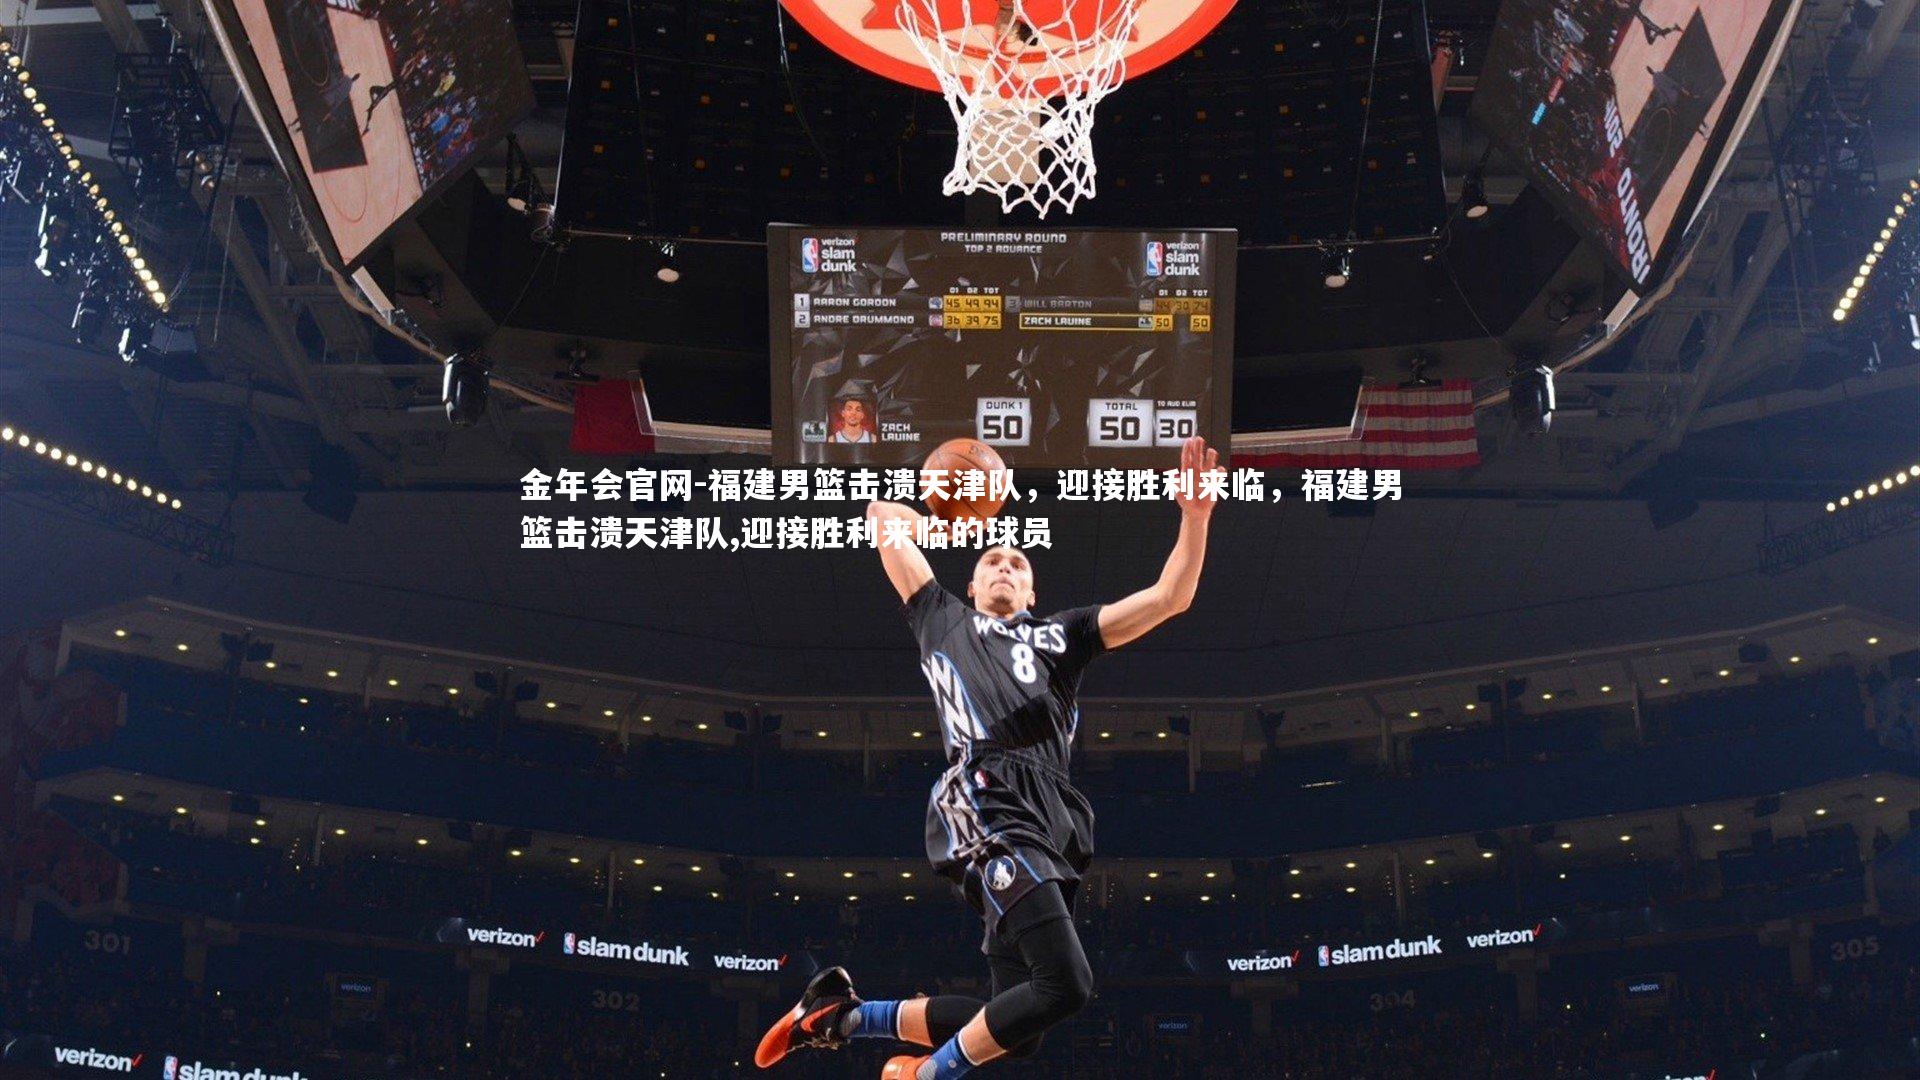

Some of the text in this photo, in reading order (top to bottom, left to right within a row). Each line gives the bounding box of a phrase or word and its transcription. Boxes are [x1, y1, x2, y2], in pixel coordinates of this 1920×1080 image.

[821, 237, 855, 246] verizon
[941, 232, 1067, 243] PRELIMINARY ROUND
[965, 244, 984, 253] TOP
[986, 245, 992, 253] 2
[1166, 241, 1200, 250] verizon
[821, 246, 856, 259] slam
[1165, 250, 1200, 263] slam
[821, 259, 857, 272] dunk
[1164, 263, 1200, 276] dunk
[813, 298, 850, 307] AARON
[853, 298, 896, 307] GORDON
[946, 298, 960, 308] 45
[965, 299, 980, 308] 49
[984, 299, 999, 308] 94
[813, 315, 849, 324] ANDRE
[853, 315, 914, 324] DRUMMOND
[947, 315, 960, 325] 36
[966, 315, 980, 325] 39
[984, 316, 999, 325] 75
[1024, 317, 1052, 325] ZACH
[1156, 318, 1170, 327] 50
[1193, 318, 1208, 327] 50
[986, 401, 1015, 410] DUNK
[1105, 402, 1138, 411] TOTAL
[882, 423, 911, 432] ZACH
[983, 415, 1023, 440] 50
[1100, 416, 1141, 441] 50
[1159, 418, 1194, 438] 30
[1011, 643, 1037, 684] 8
[467, 927, 536, 948] verizon
[1466, 927, 1534, 948] verizon
[577, 936, 690, 966] slam dunk
[1331, 935, 1443, 965] slam dunk
[714, 954, 779, 971] verizon
[1227, 953, 1292, 972] verizon
[55, 1046, 132, 1073] verizon
